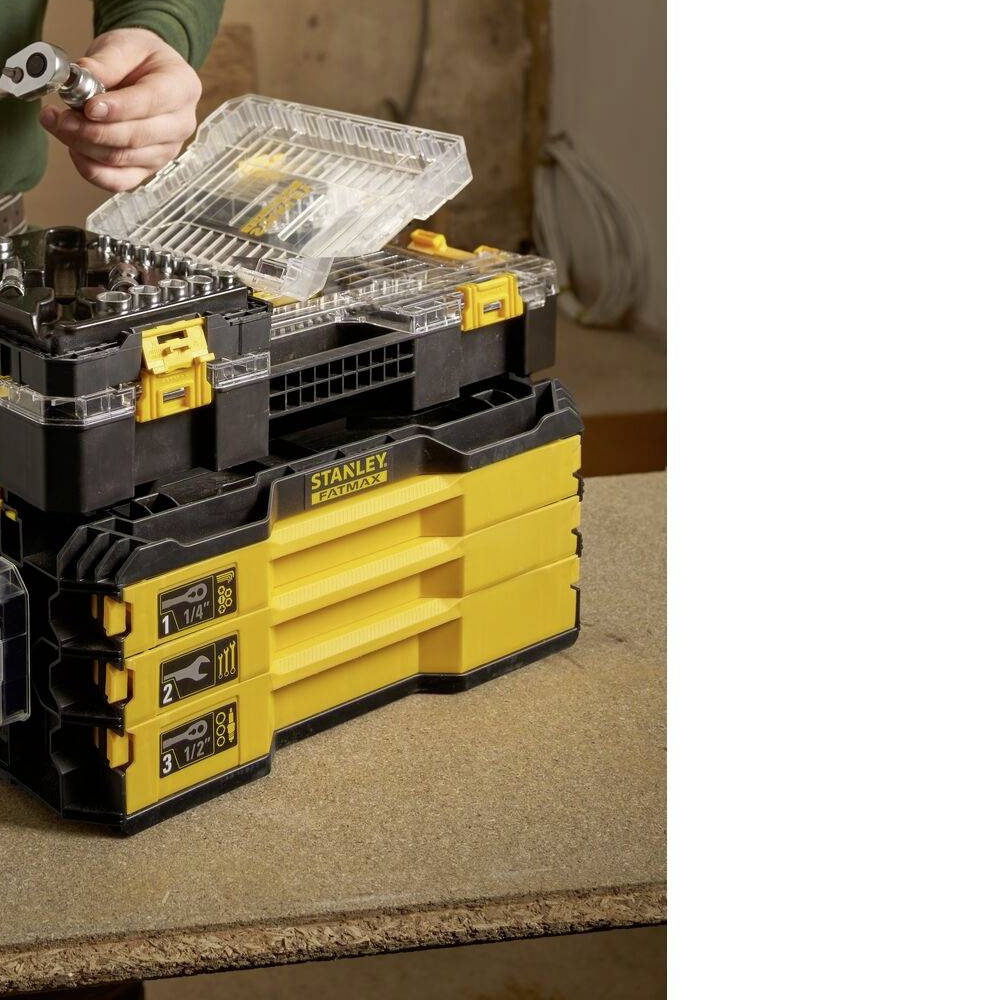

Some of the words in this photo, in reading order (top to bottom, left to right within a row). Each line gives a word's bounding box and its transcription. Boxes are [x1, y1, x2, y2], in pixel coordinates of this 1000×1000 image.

[311, 451, 387, 490] STANLEY
[319, 473, 381, 501] FATMAX
[162, 614, 170, 635] 1
[162, 682, 173, 704] 2
[162, 752, 173, 774] 3
